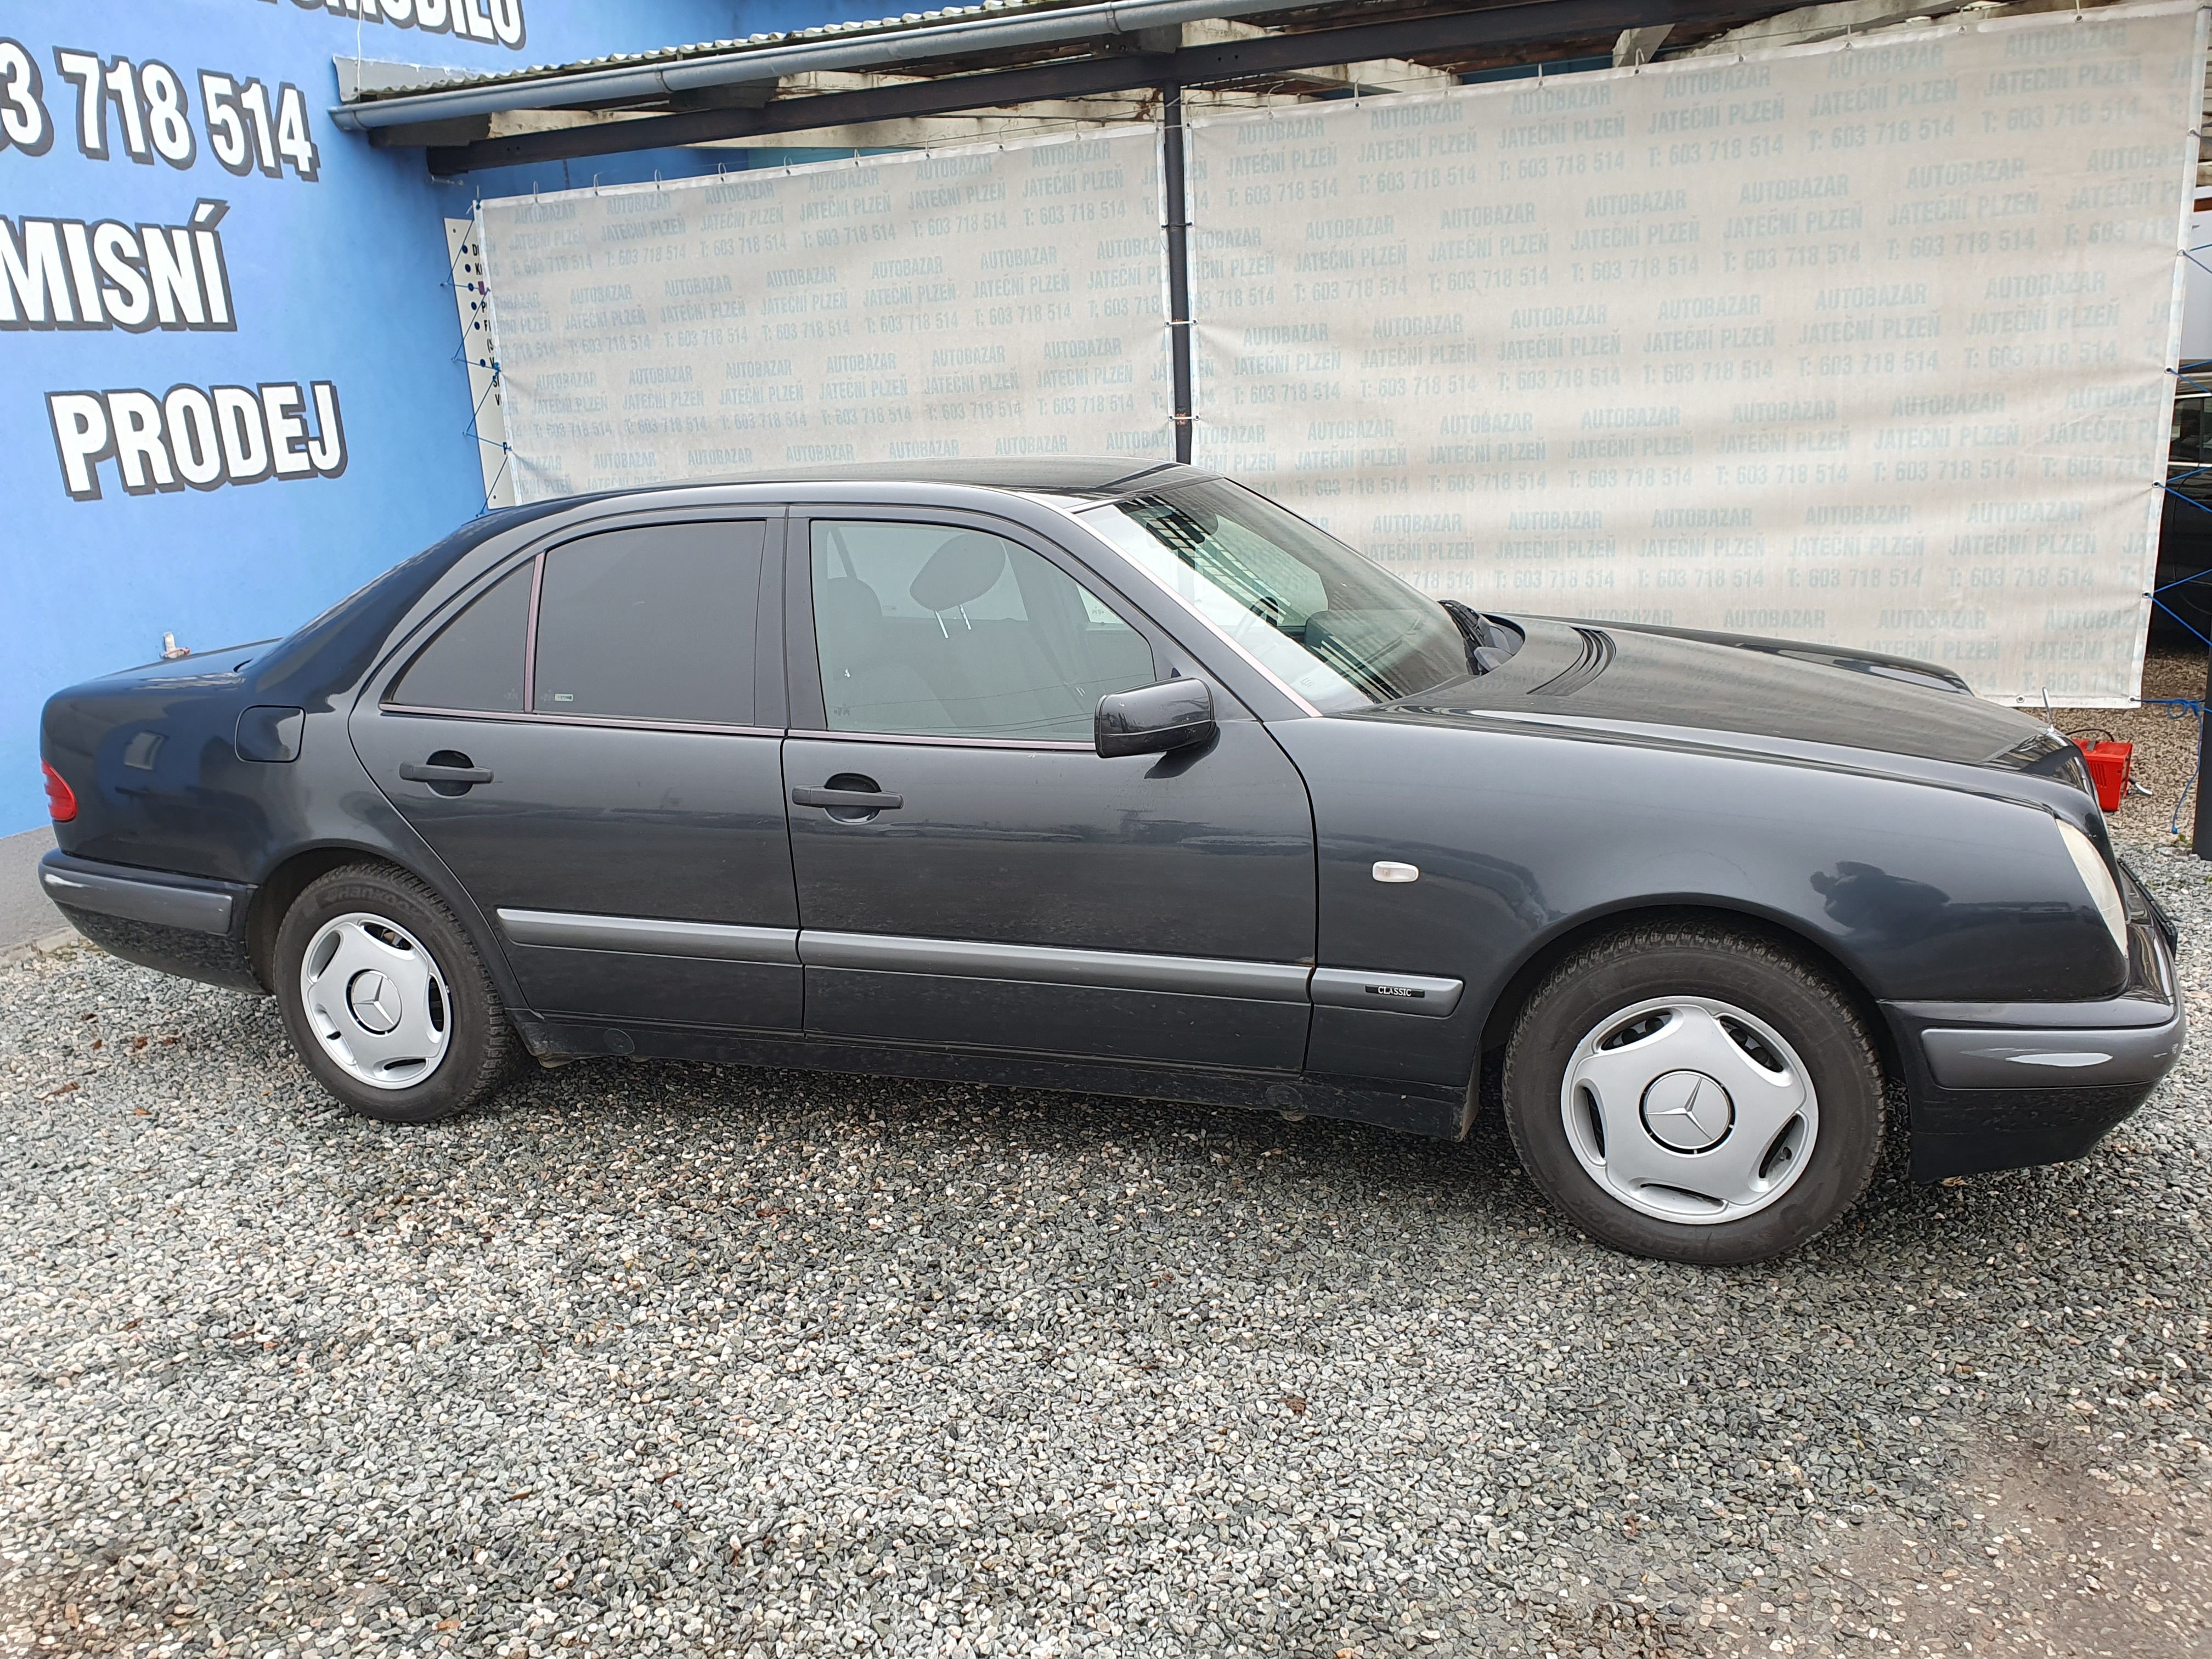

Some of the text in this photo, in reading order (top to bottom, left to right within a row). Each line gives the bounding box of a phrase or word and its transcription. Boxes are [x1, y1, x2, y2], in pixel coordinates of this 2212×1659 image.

[1663, 63, 1770, 99] AUTOBAZAR
[57, 49, 193, 165] 718
[200, 72, 316, 177] 514
[1370, 100, 1463, 130] AUTOBAZAR
[1648, 89, 1785, 134] JATEČNÍ PLZEŇ
[1237, 115, 1324, 145] AUTOBAZAR
[1357, 124, 1477, 163] JATEČNÍ PLZEŇ
[1032, 139, 1111, 167] AUTOBAZAR
[1226, 139, 1338, 177] JATEČNÍ PLZEŇ
[1647, 132, 1785, 168] T: 603 718 514
[916, 153, 992, 180] AUTOBAZAR
[1023, 162, 1125, 198] JATEČNÍ PLZEŇ
[1357, 163, 1477, 195] T: 603 718 514
[706, 180, 774, 206] AUTOBAZAR
[1227, 177, 1339, 207] T: 603 718 514
[1739, 173, 1849, 205] AUTOBAZAR
[926, 216, 951, 237] 603
[955, 213, 979, 234] 718
[983, 210, 1008, 231] 514
[1024, 199, 1127, 227] T: 603 718 514
[1441, 201, 1536, 230] AUTOBAZAR
[1722, 200, 1861, 240] JATEČNÍ PLZEŇ
[1305, 214, 1395, 241] AUTOBAZAR
[713, 238, 735, 256] 603
[738, 235, 760, 254] 718
[764, 232, 786, 251] 514
[1293, 238, 1407, 273] JATEČNÍ PLZEŇ
[1428, 225, 1549, 262] JATEČNÍ PLZEŇ
[1720, 240, 1860, 273] T: 603 718 514
[872, 256, 943, 279] AUTOBAZAR
[981, 245, 1057, 270] AUTOBAZAR
[665, 274, 733, 297] AUTOBAZAR
[864, 276, 956, 307] JATEČNÍ PLZEŇ
[972, 267, 1070, 299] JATEČNÍ PLZEŇ
[1294, 275, 1408, 303] T: 603 718 514
[1428, 264, 1550, 292] T: 603 718 514
[661, 295, 746, 323] JATEČNÍ PLZEŇ
[865, 310, 960, 335] T: 603 718 514
[973, 301, 1072, 326] T: 603 718 514
[1510, 303, 1607, 330] AUTOBAZAR
[663, 326, 749, 347] T: 603 718 514
[1243, 321, 1329, 346] AUTOBAZAR
[1497, 328, 1621, 361] JATEČNÍ PLZEŇ
[1044, 336, 1121, 360] AUTOBAZAR
[827, 352, 896, 373] AUTOBAZAR
[1036, 359, 1133, 388] JATEČNÍ PLZEŇ
[819, 373, 909, 400] JATEČNÍ PLZEŇ
[1497, 365, 1621, 391] T: 603 718 514
[1037, 392, 1135, 415] T: 603 718 514
[1249, 383, 1275, 404] 603
[1281, 382, 1307, 403] 718
[1313, 380, 1341, 401] 514
[1891, 391, 2005, 417] AUTOBAZAR
[821, 404, 912, 426] T: 603 718 514
[1440, 413, 1533, 435] AUTOBAZAR
[1581, 406, 1680, 429] AUTOBAZAR
[48, 382, 344, 496] PRODEJ
[995, 435, 1068, 455] AUTOBAZAR
[1567, 430, 1693, 459] JATEČNÍ PLZEŇ
[1873, 417, 2018, 450] JATEČNÍ PLZEŇ
[688, 448, 752, 466] AUTOBAZAR
[889, 439, 959, 459] AUTOBAZAR
[1427, 435, 1547, 464] JATEČNÍ PLZEŇ
[1427, 470, 1548, 493] T: 603 718 514
[1567, 465, 1693, 488] T: 603 718 514
[1871, 457, 2017, 482] T: 603 718 514
[1508, 510, 1602, 531] AUTOBAZAR
[1513, 569, 1543, 589] 603
[1549, 568, 1578, 588] 718
[1585, 568, 1615, 588] 514
[1378, 986, 1412, 996] CLASSIC
